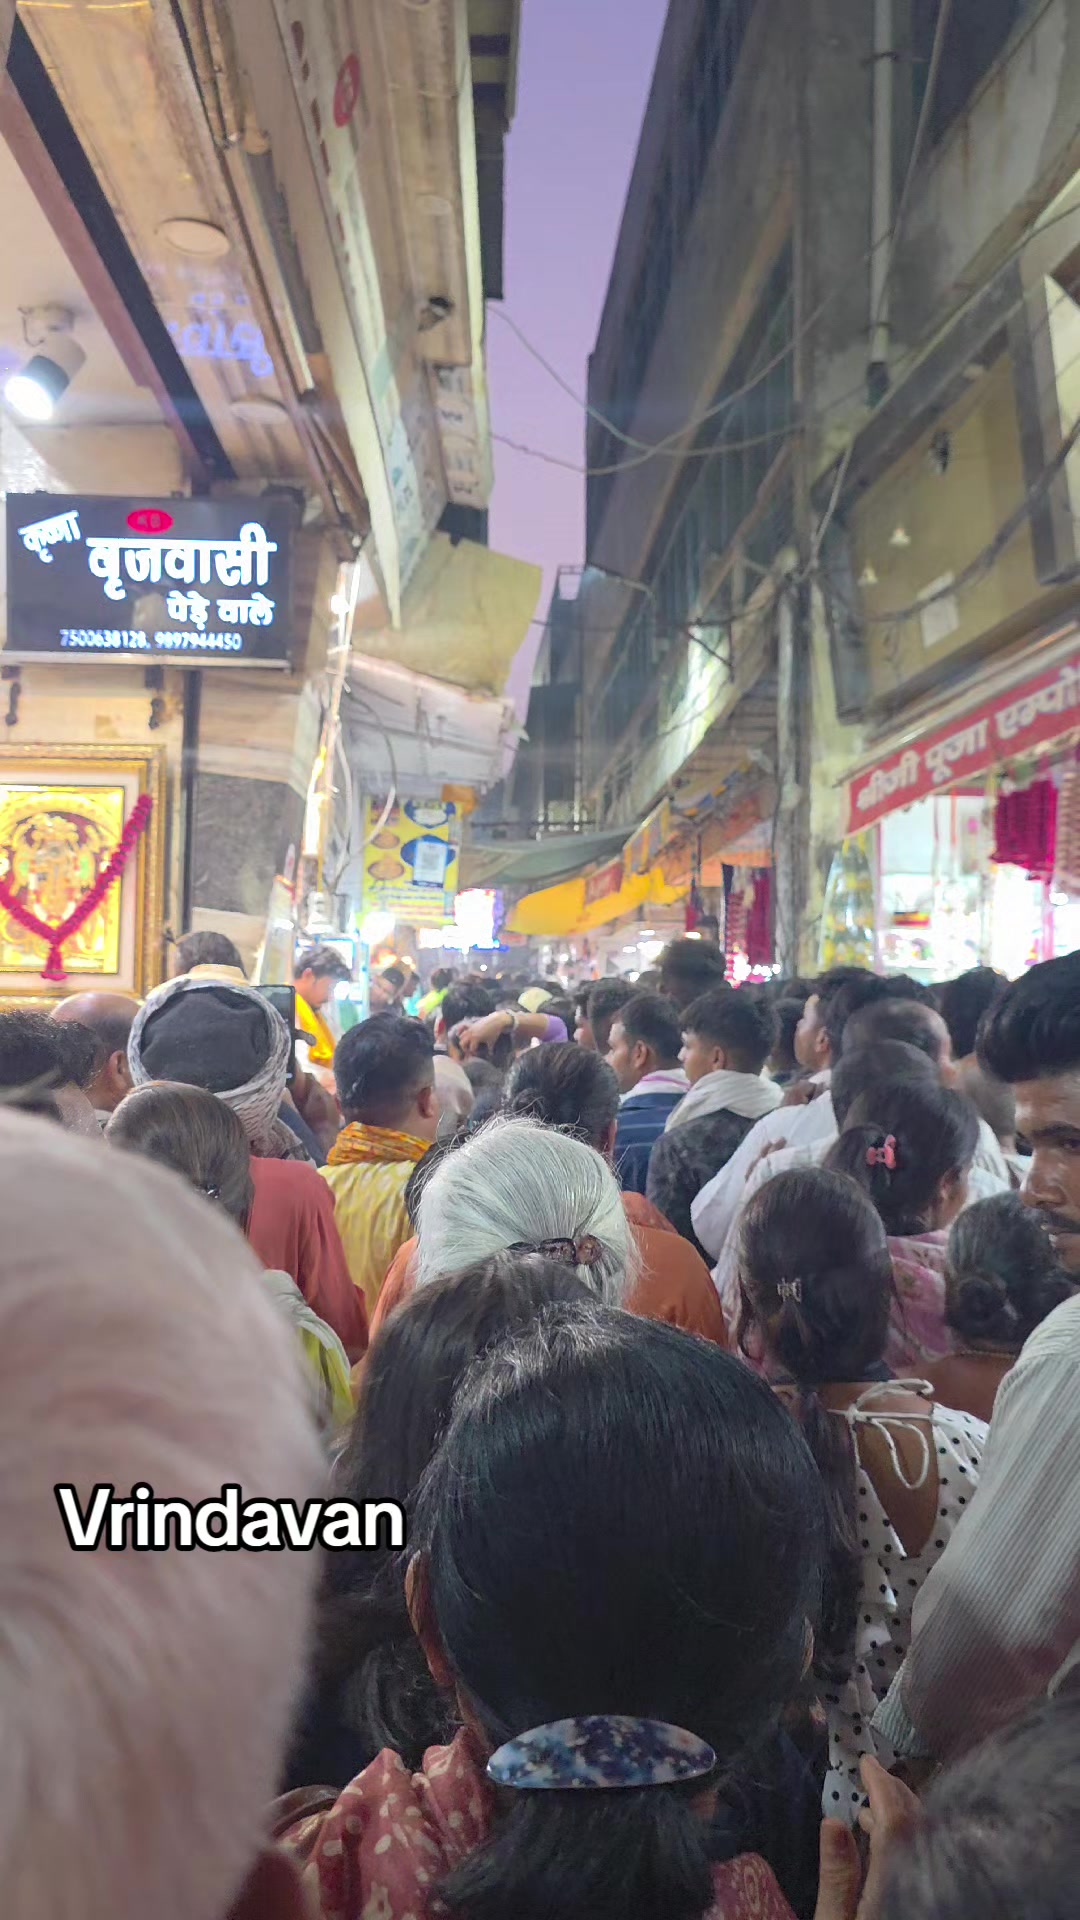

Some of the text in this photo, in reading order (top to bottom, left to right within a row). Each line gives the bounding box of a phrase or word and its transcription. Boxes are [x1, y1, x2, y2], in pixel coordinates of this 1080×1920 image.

[17, 509, 82, 564] कृष्णा
[216, 591, 276, 626] वाले
[924, 718, 988, 784] पूजा
[994, 666, 1080, 740] एम्पो
